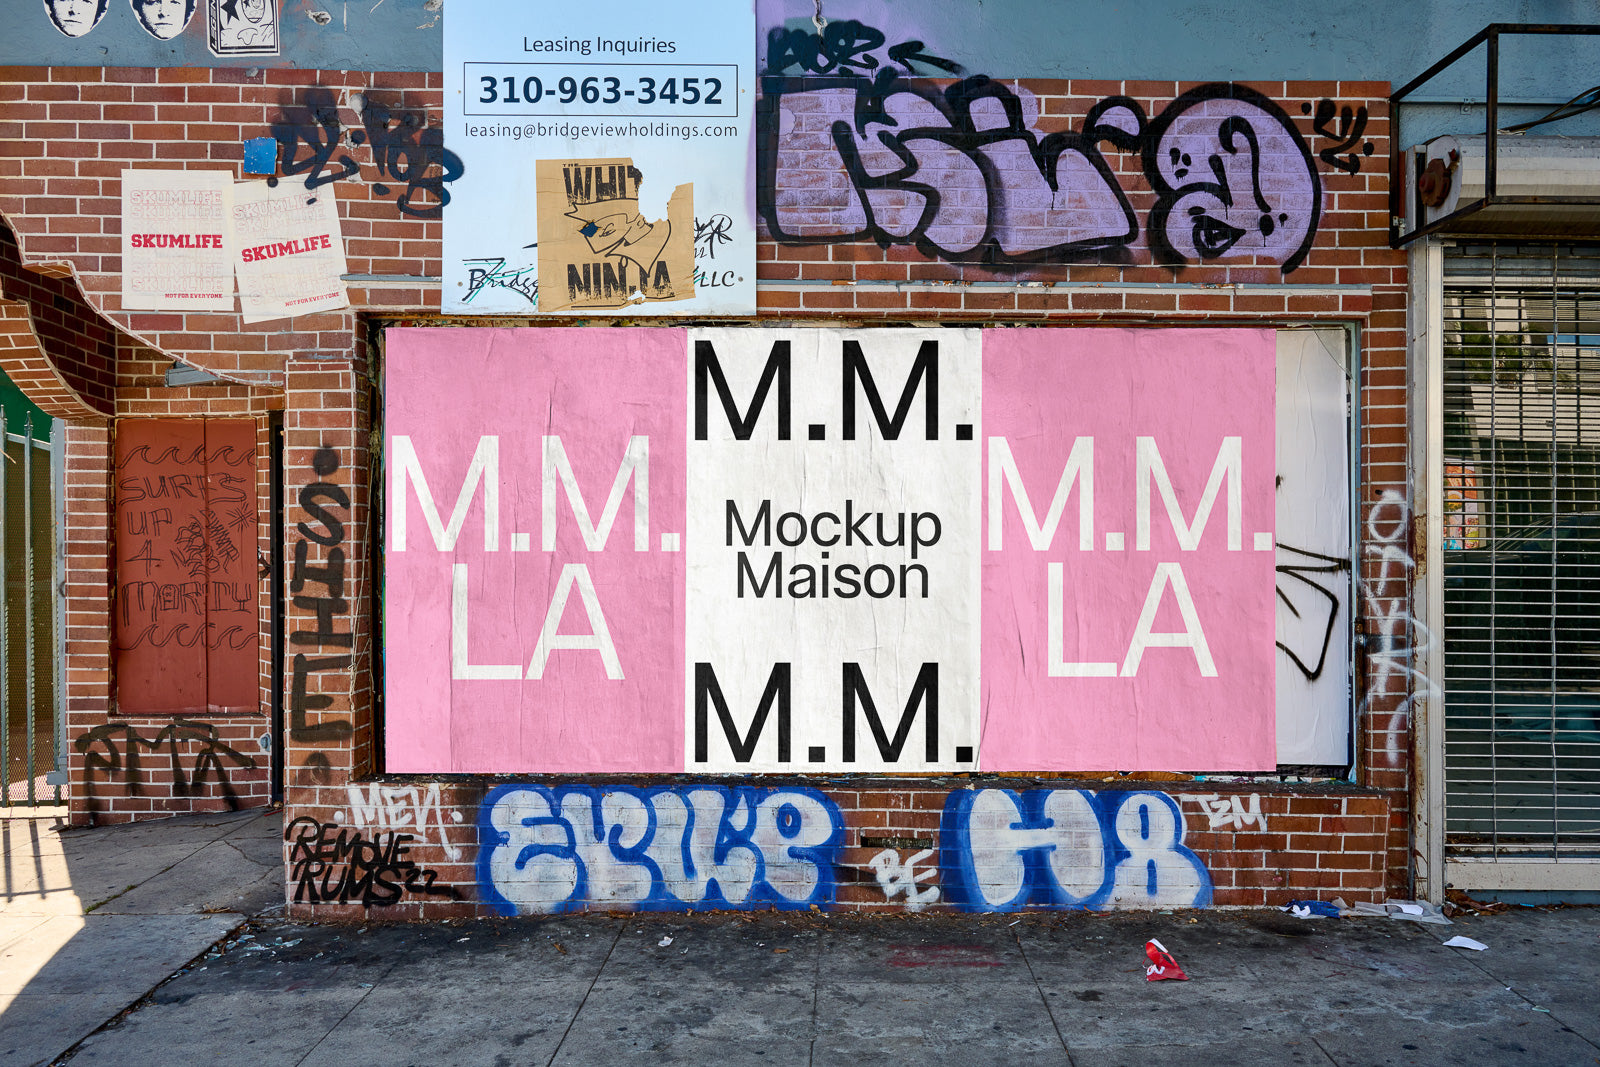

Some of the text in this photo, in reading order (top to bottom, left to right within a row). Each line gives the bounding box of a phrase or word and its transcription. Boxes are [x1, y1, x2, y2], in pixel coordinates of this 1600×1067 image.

[523, 36, 677, 56] Leasing Inquiries
[479, 75, 723, 105] 310-963-3452
[465, 122, 738, 140] leasing@bridgeviewholdings.com
[562, 165, 643, 204] WHIT
[131, 233, 223, 249] SKUMLIFE
[241, 233, 332, 263] SKUMLIFE
[700, 270, 735, 288] LLC
[284, 291, 340, 307] NOT FOR EVERYONE
[694, 340, 973, 440] M.M.
[391, 435, 680, 551] M.M.
[988, 436, 1272, 551] M.M.
[126, 507, 172, 537] UP
[725, 499, 942, 559] Mockup
[737, 551, 929, 598] Maison
[452, 563, 625, 679] LA
[1048, 562, 1219, 677] LA
[694, 662, 973, 762] M.M.
[285, 816, 416, 872] REMOVE
[404, 867, 463, 901] 22
